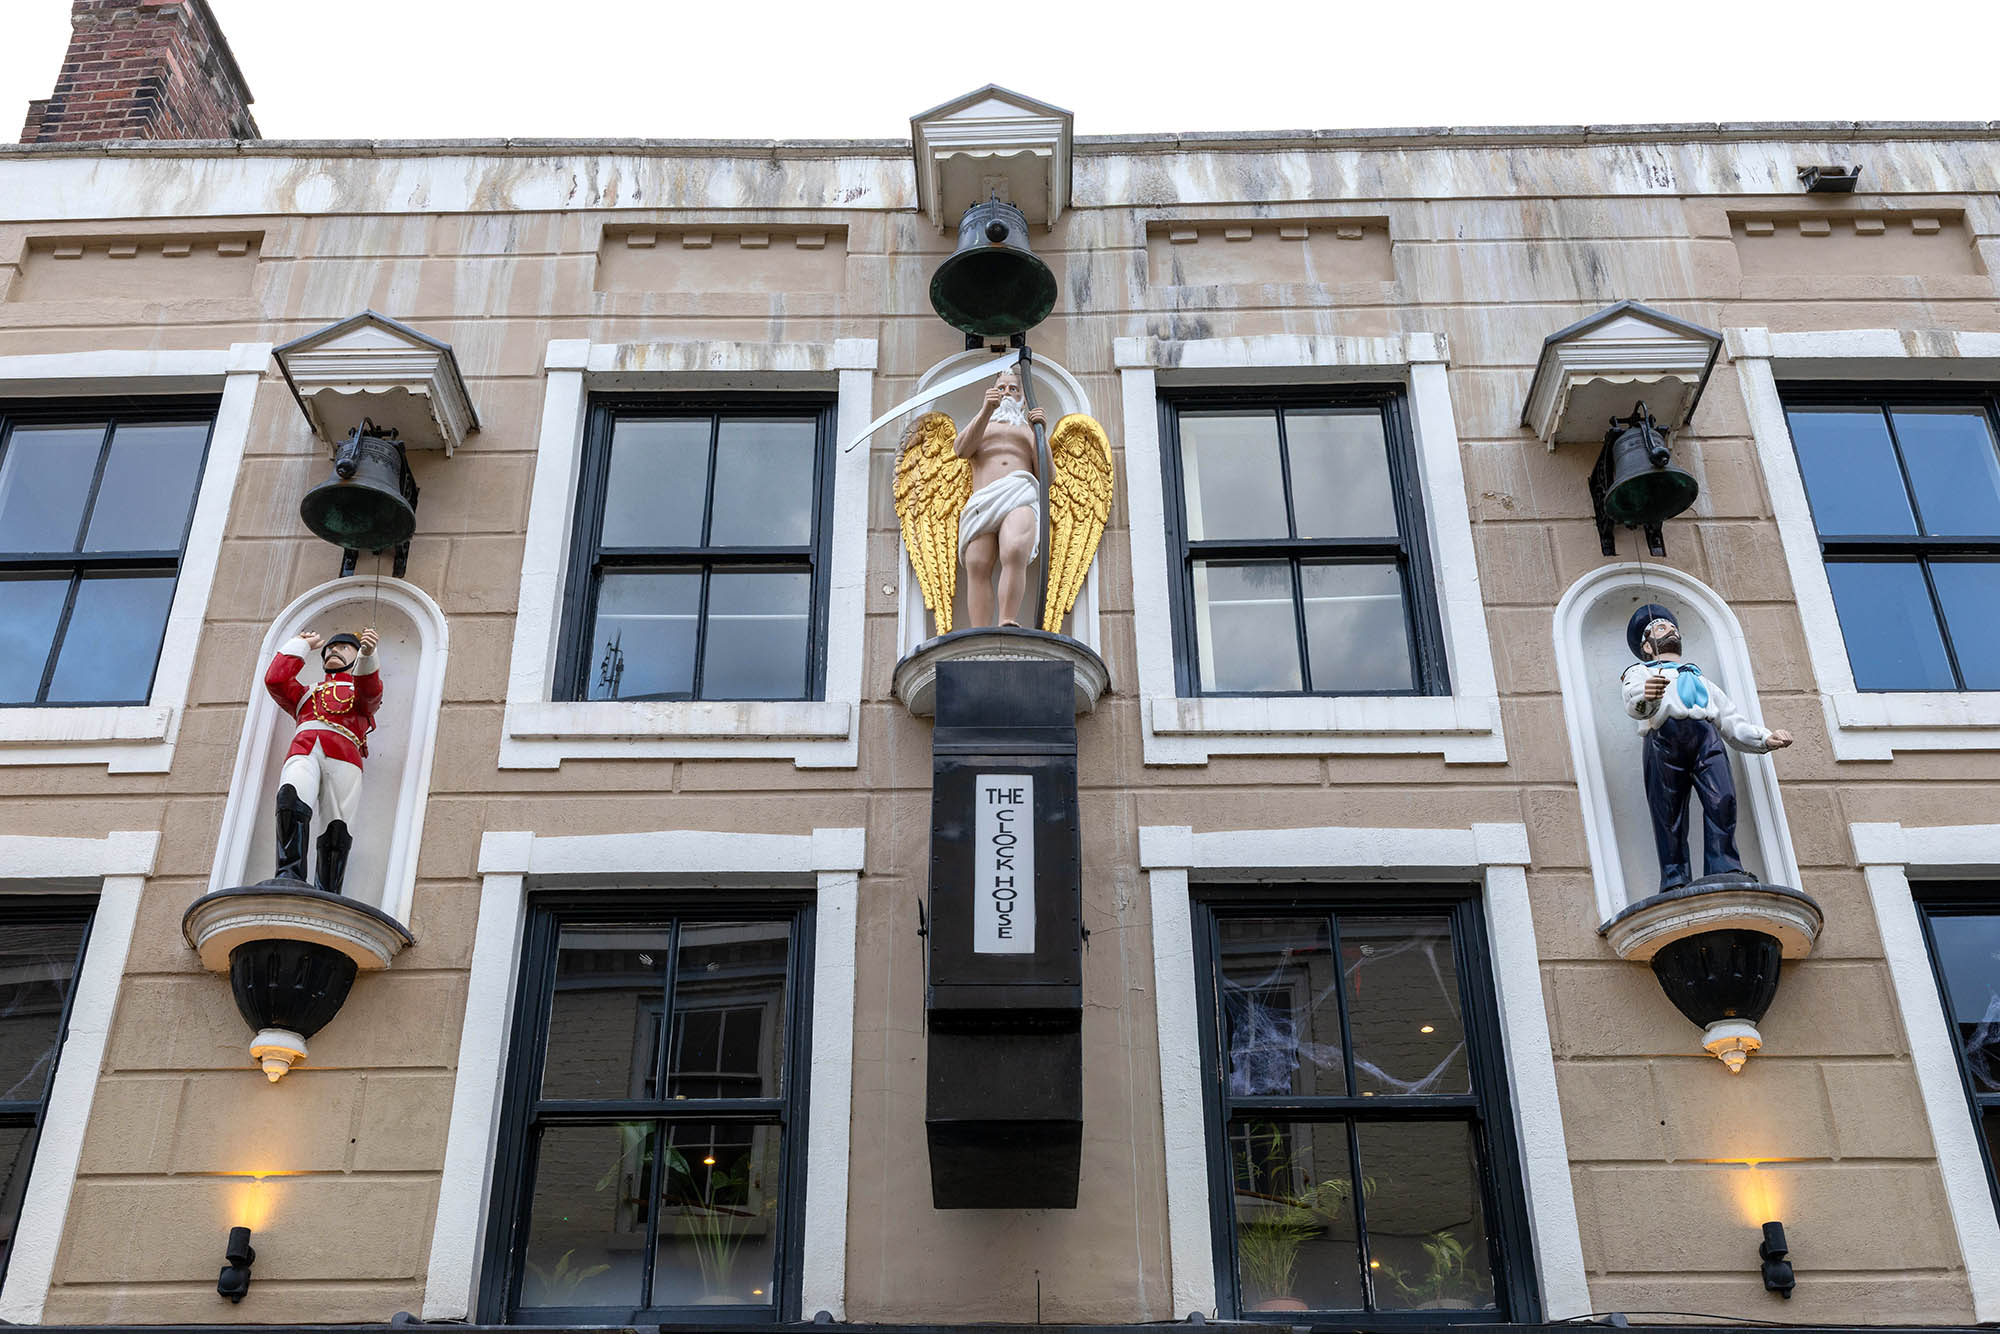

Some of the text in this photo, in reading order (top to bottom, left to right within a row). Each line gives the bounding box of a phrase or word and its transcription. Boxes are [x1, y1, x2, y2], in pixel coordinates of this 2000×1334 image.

[985, 788, 1024, 804] THE
[992, 810, 1017, 938] CLOCK HOUSE
